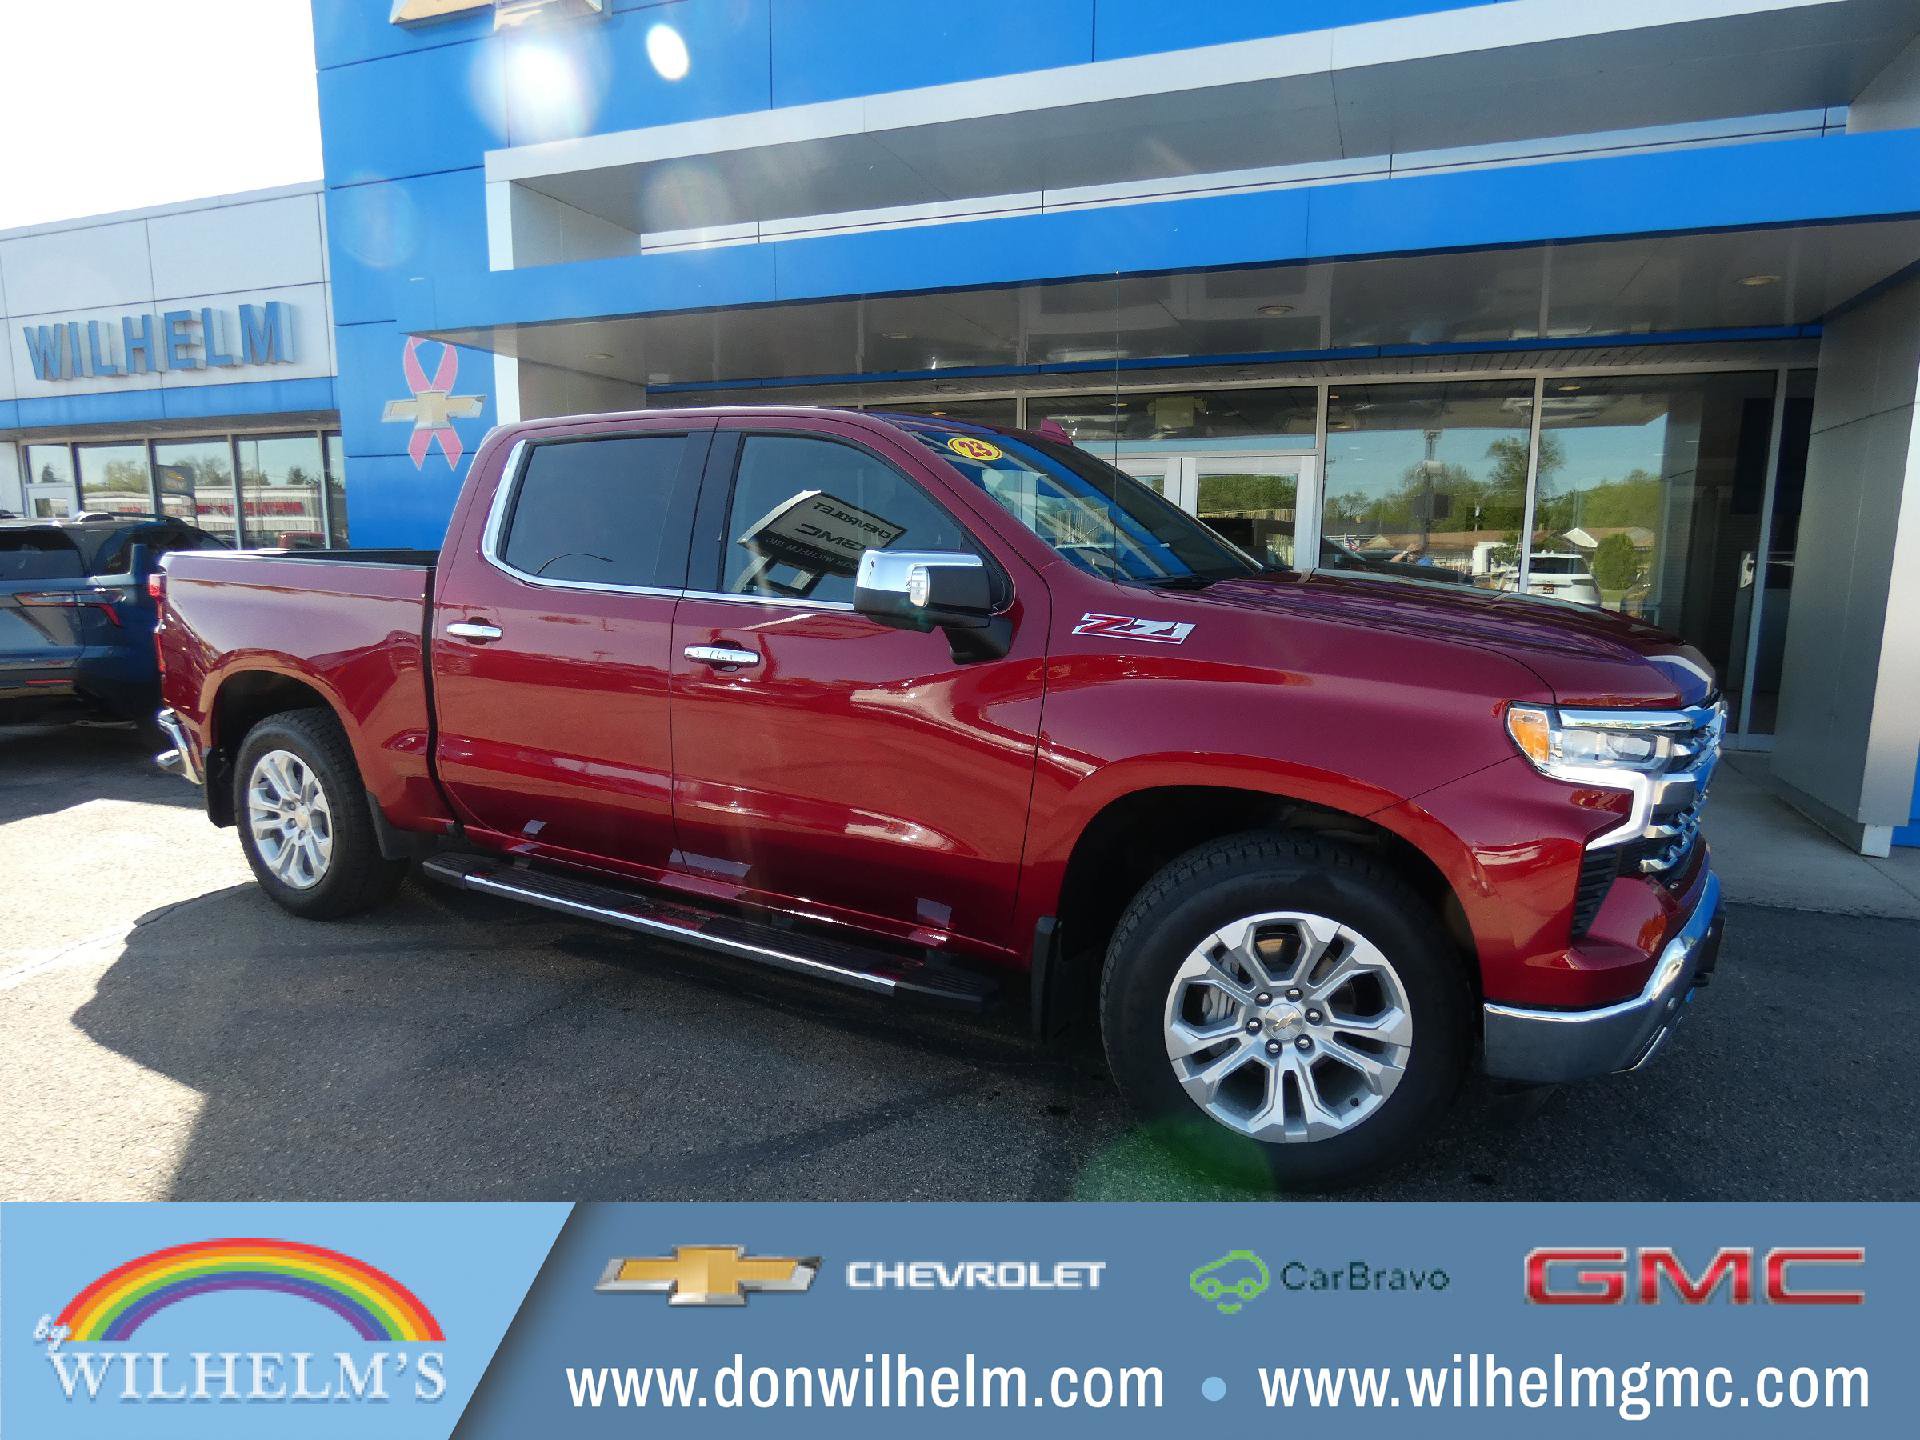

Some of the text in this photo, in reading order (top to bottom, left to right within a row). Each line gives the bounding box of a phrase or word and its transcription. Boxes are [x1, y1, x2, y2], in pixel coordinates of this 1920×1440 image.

[22, 301, 292, 381] WILHELM
[957, 440, 993, 458] 23
[1071, 612, 1197, 645] Z71
